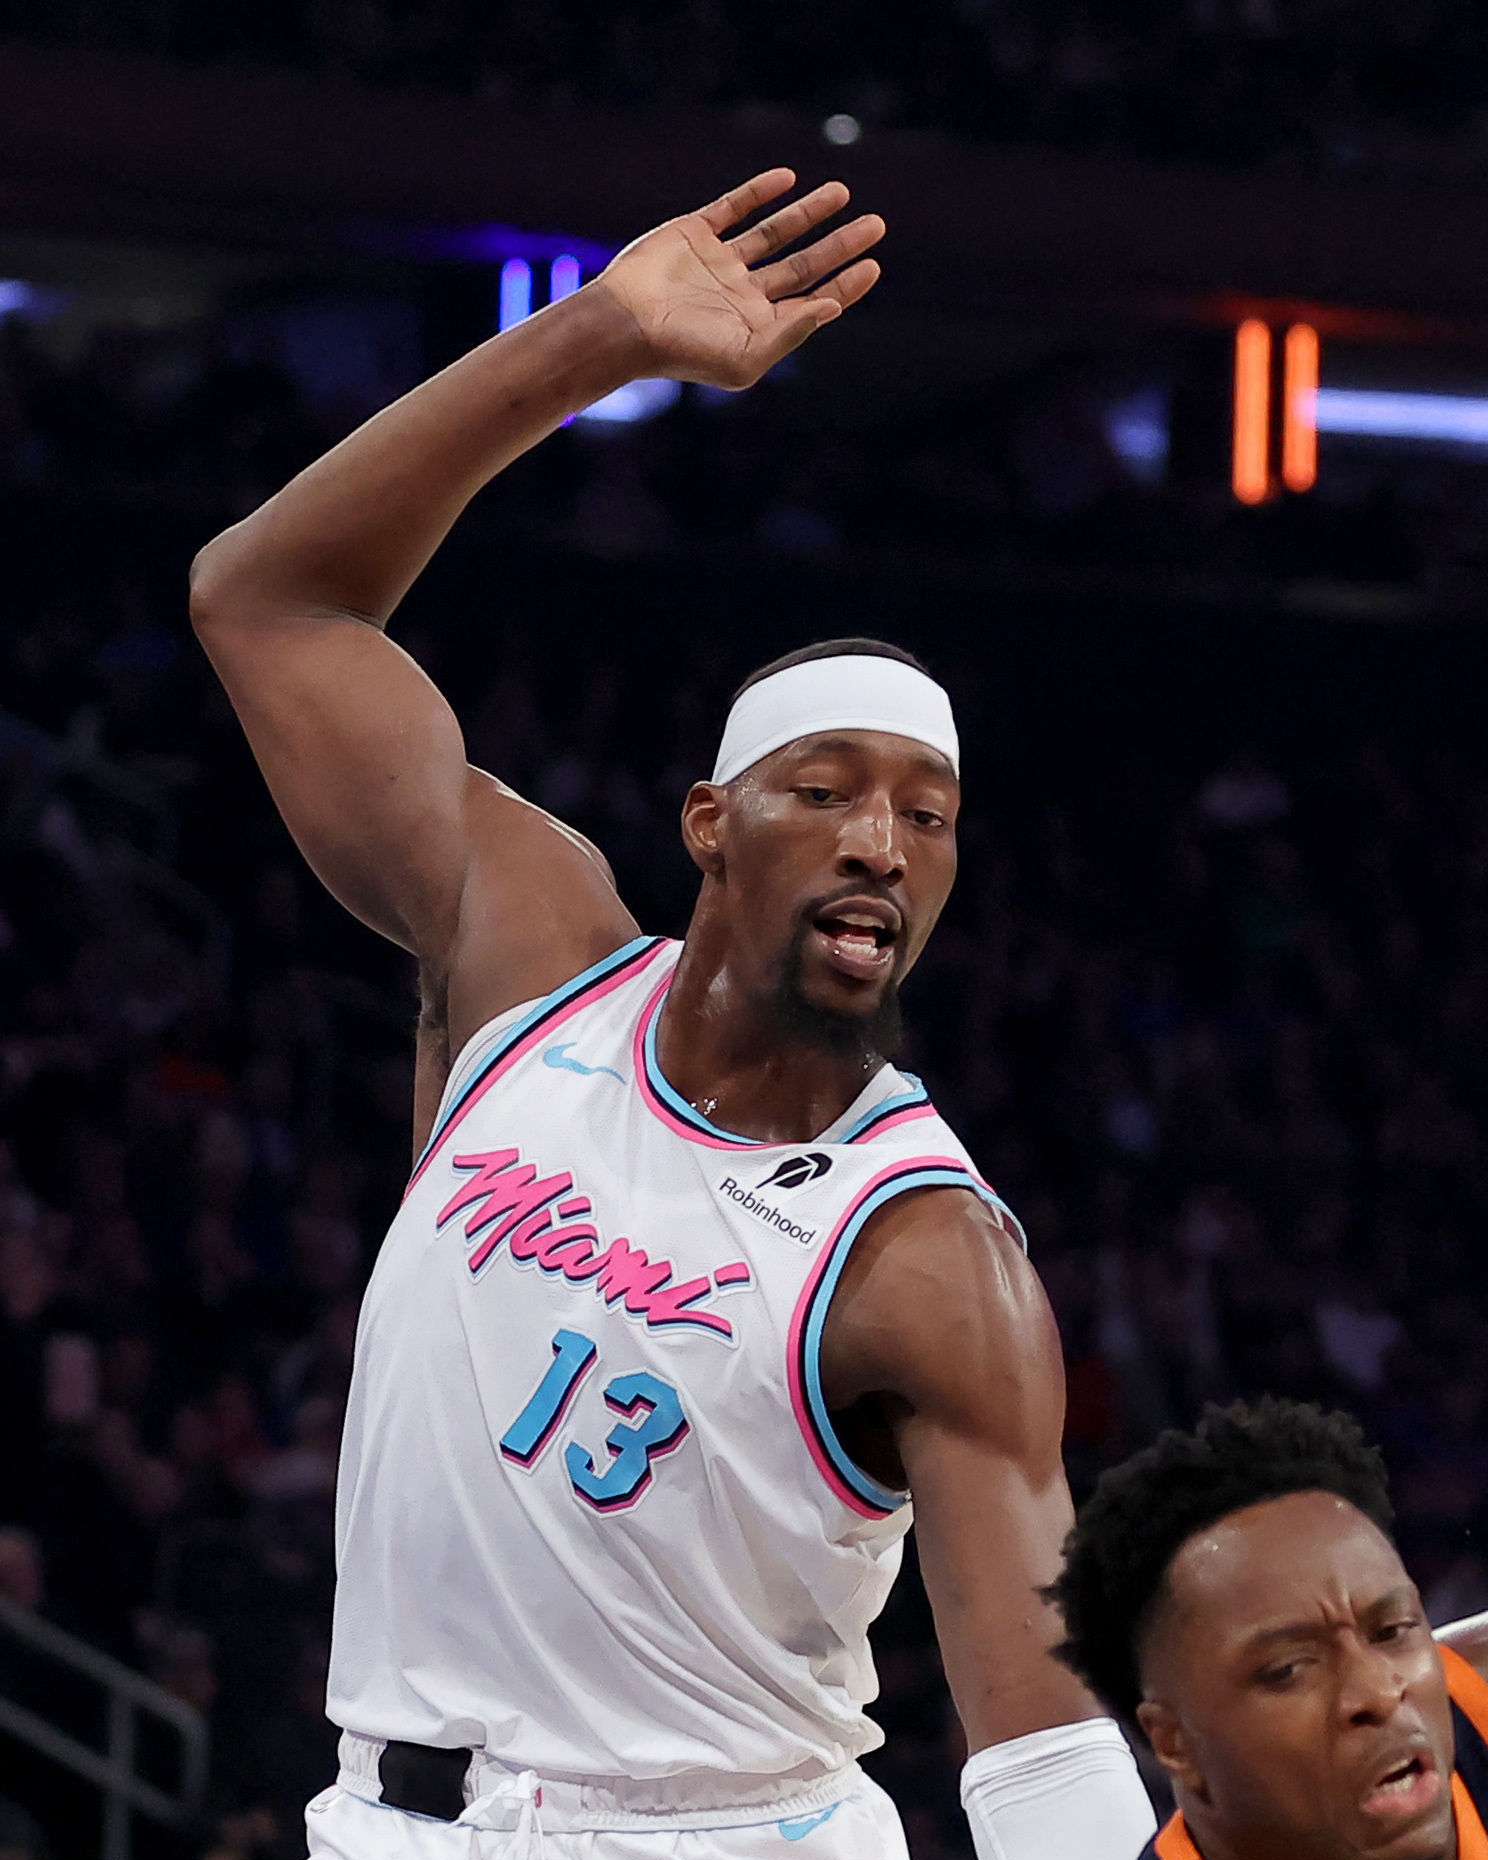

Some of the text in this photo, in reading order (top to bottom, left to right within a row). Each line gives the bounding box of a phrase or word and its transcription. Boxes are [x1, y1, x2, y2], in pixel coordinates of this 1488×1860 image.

[437, 1147, 751, 1340] Miami
[719, 1177, 817, 1246] Robinhood
[499, 1328, 691, 1514] 13
